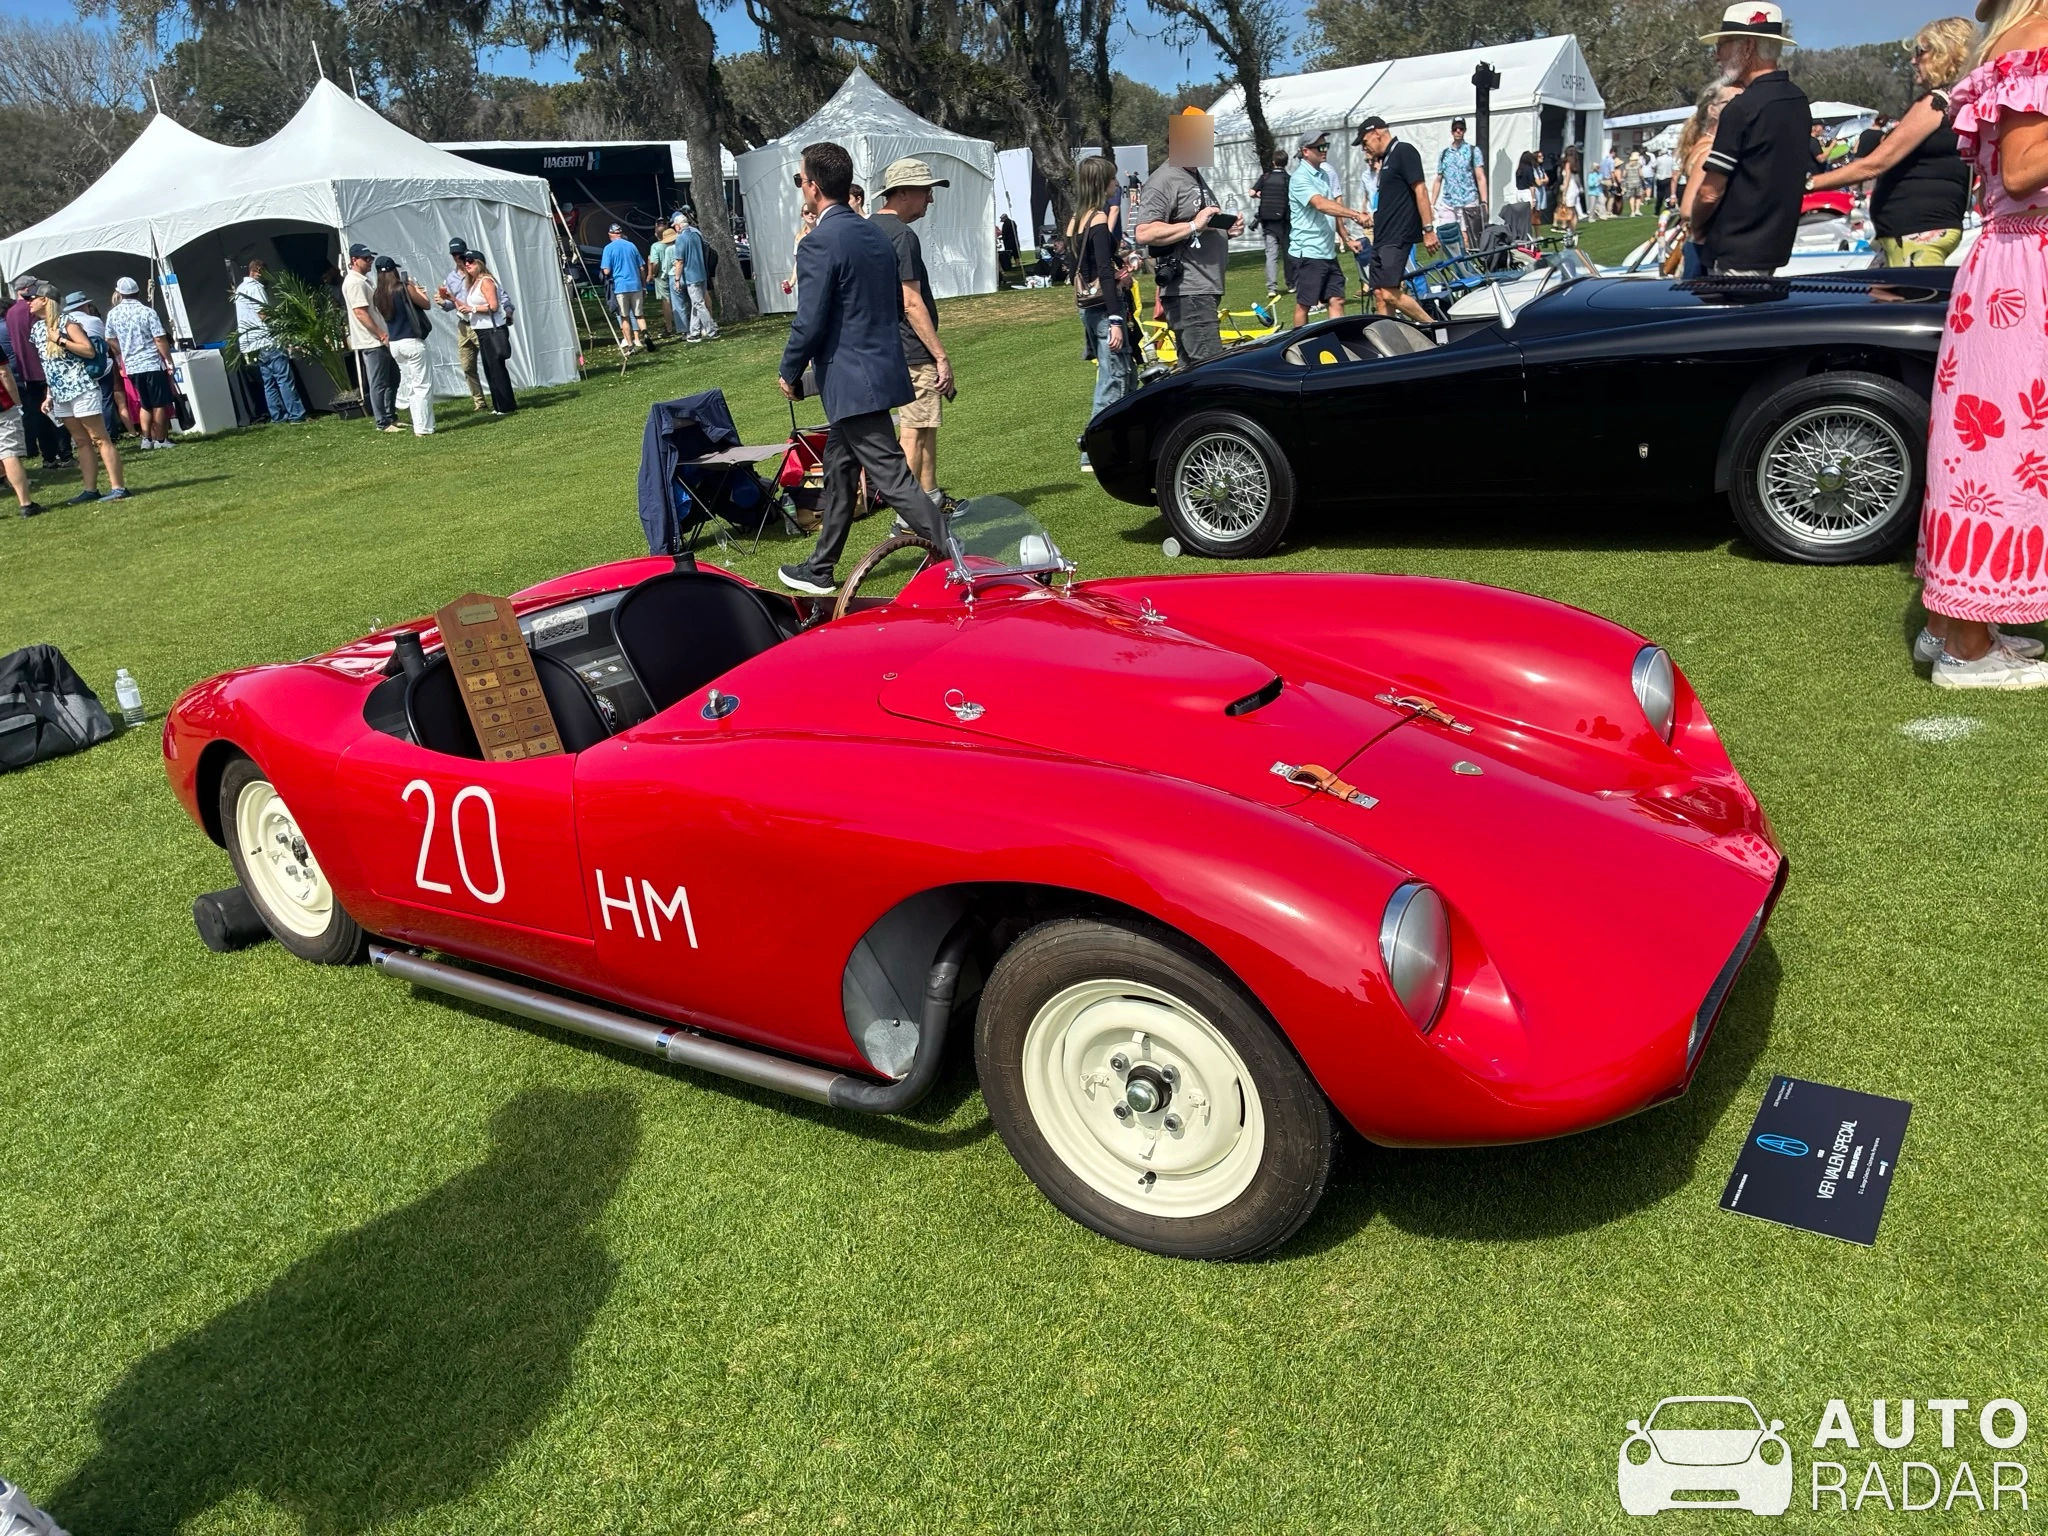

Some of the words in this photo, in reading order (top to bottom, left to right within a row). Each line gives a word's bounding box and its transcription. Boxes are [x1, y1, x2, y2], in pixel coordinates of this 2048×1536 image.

[543, 155, 585, 168] HAGERTY
[402, 779, 506, 904] 20
[595, 869, 699, 950] HM
[1833, 1120, 1858, 1153] SPECIAL
[1823, 1152, 1846, 1180] VALEN
[1817, 1180, 1836, 1199] VER
[1216, 1189, 1270, 1232] MICHELIN
